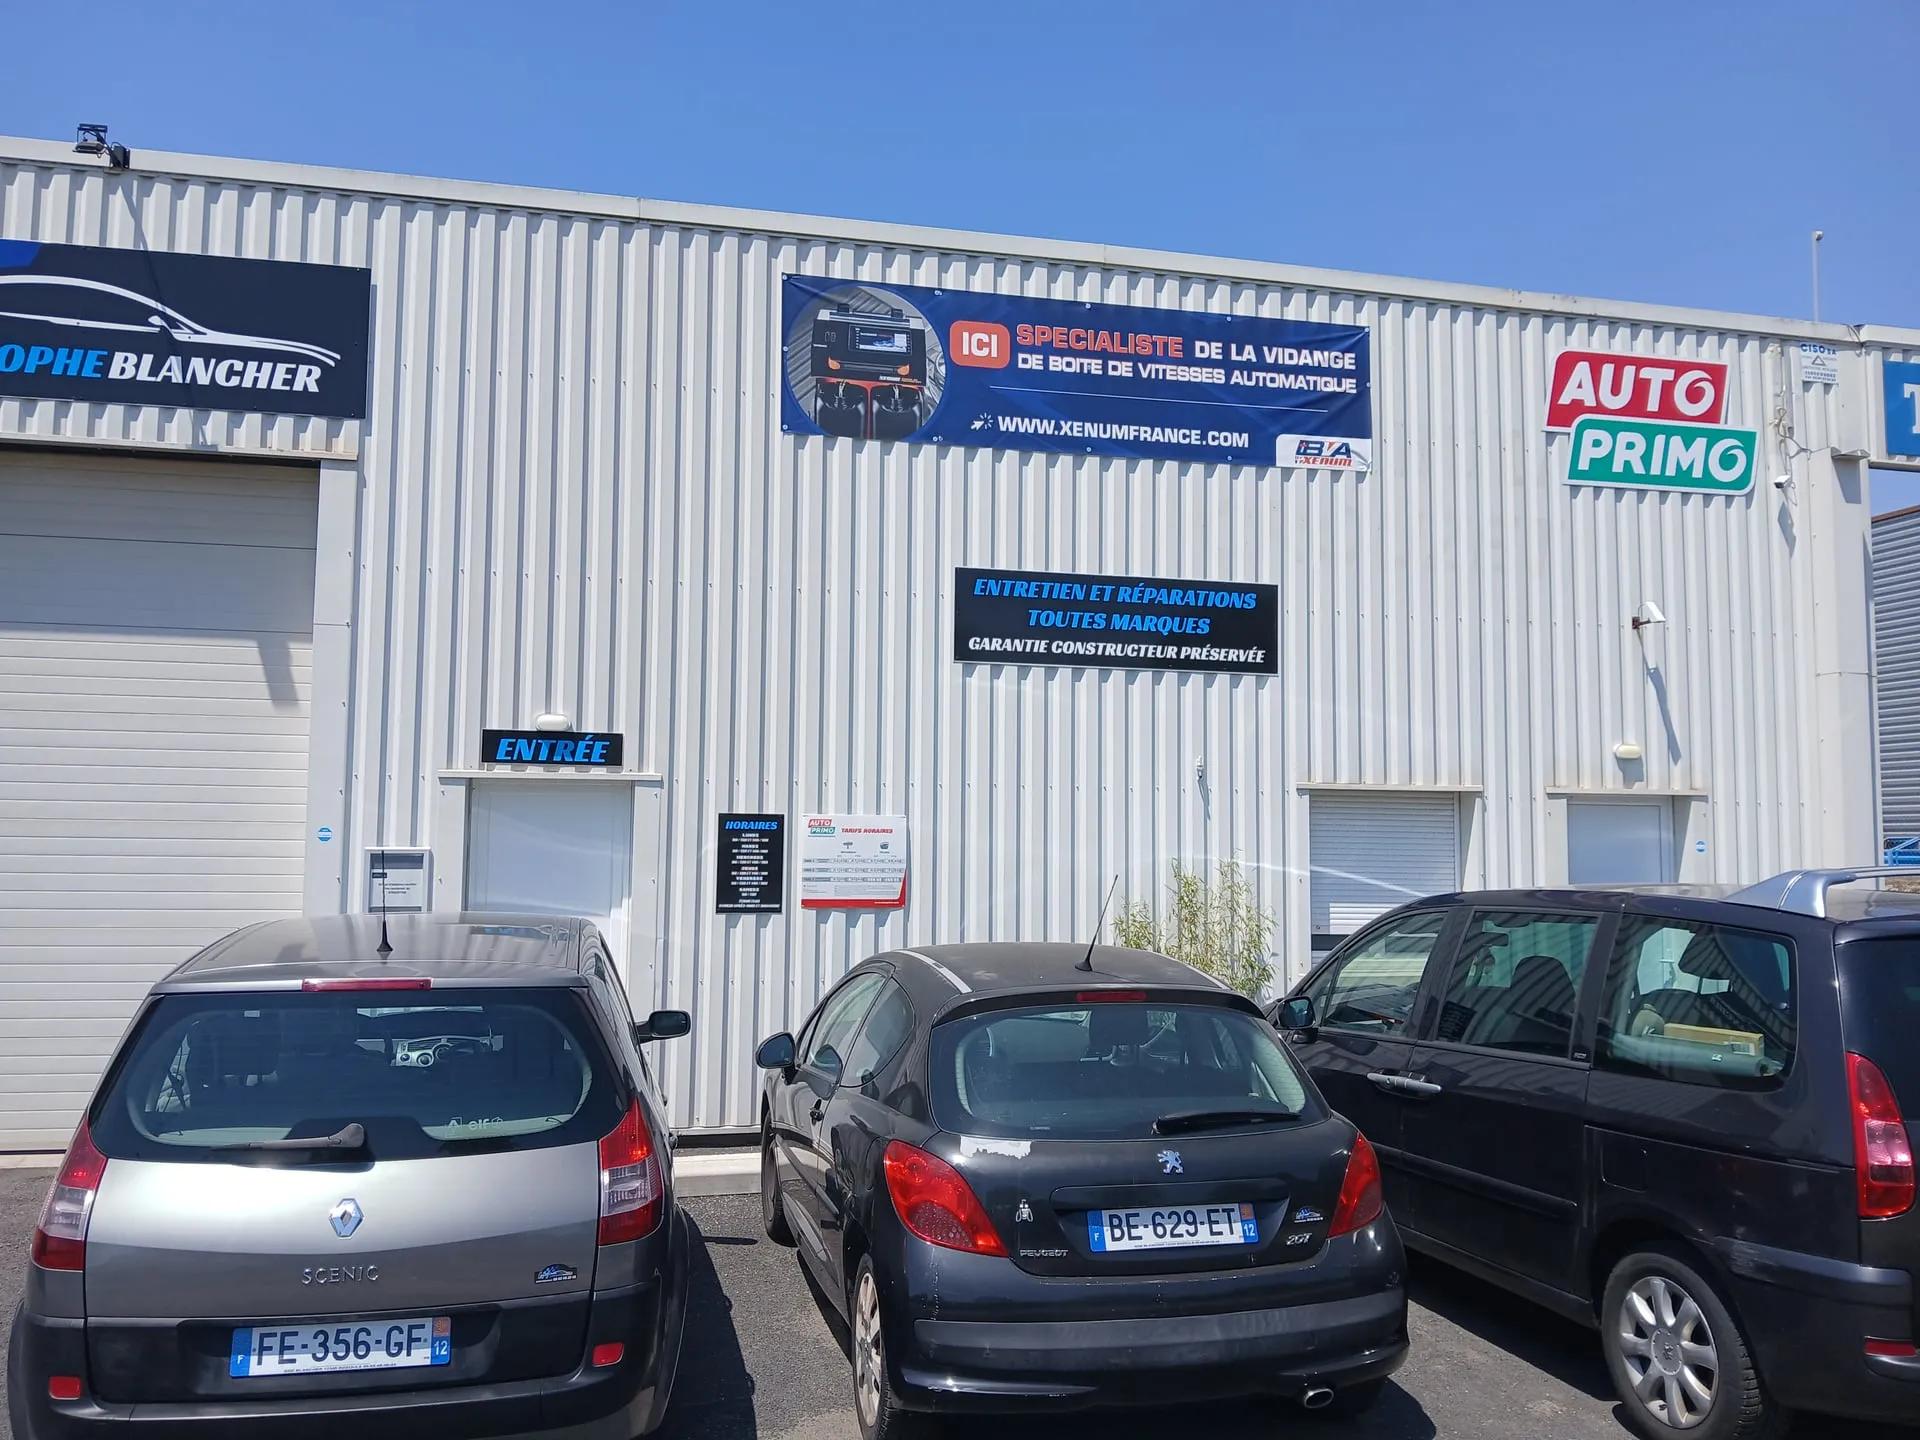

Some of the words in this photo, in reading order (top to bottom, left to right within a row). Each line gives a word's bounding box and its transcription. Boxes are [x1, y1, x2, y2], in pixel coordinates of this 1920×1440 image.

[961, 331, 998, 358] ICI
[1016, 323, 1184, 358] SPECIALISTE
[1194, 340, 1223, 360] DE
[1230, 343, 1257, 363] LA
[1262, 346, 1357, 371] VIDANGE
[107, 351, 322, 393] BLANCHER
[1017, 353, 1044, 370] DE
[1048, 354, 1103, 376] BOITE
[1107, 360, 1133, 378] DE
[1138, 363, 1226, 385] VITESSES
[1229, 369, 1357, 394] AUTOMATIQUE
[1557, 360, 1715, 417] AUTO
[997, 415, 1249, 448] WWW.XENUMFRANCE.COM
[1576, 428, 1747, 483] PRIMO
[973, 578, 1087, 601] ENTRETIEN
[1089, 584, 1115, 602] ET
[1118, 582, 1257, 609] RÉPARATIONS
[1028, 609, 1106, 630] TOUTES
[1110, 613, 1211, 636] MARQUES
[968, 636, 1049, 654] GARANTIE
[1051, 639, 1178, 660] CONSTRUCTEUR
[1180, 643, 1266, 663] PRÉSERVÉE
[495, 734, 610, 763] ENTRÉE
[724, 820, 778, 830] HORAIRES
[809, 819, 831, 827] AUTO
[1093, 1231, 1100, 1242] F
[1108, 1207, 1236, 1243] BE-629-ET
[1243, 1223, 1256, 1237] 12
[1019, 1248, 1069, 1258] PEUGEOT
[301, 1265, 379, 1286] SCENIC
[256, 1322, 427, 1367] FE-356-GF
[433, 1339, 449, 1357] 12
[236, 1353, 246, 1366] F
